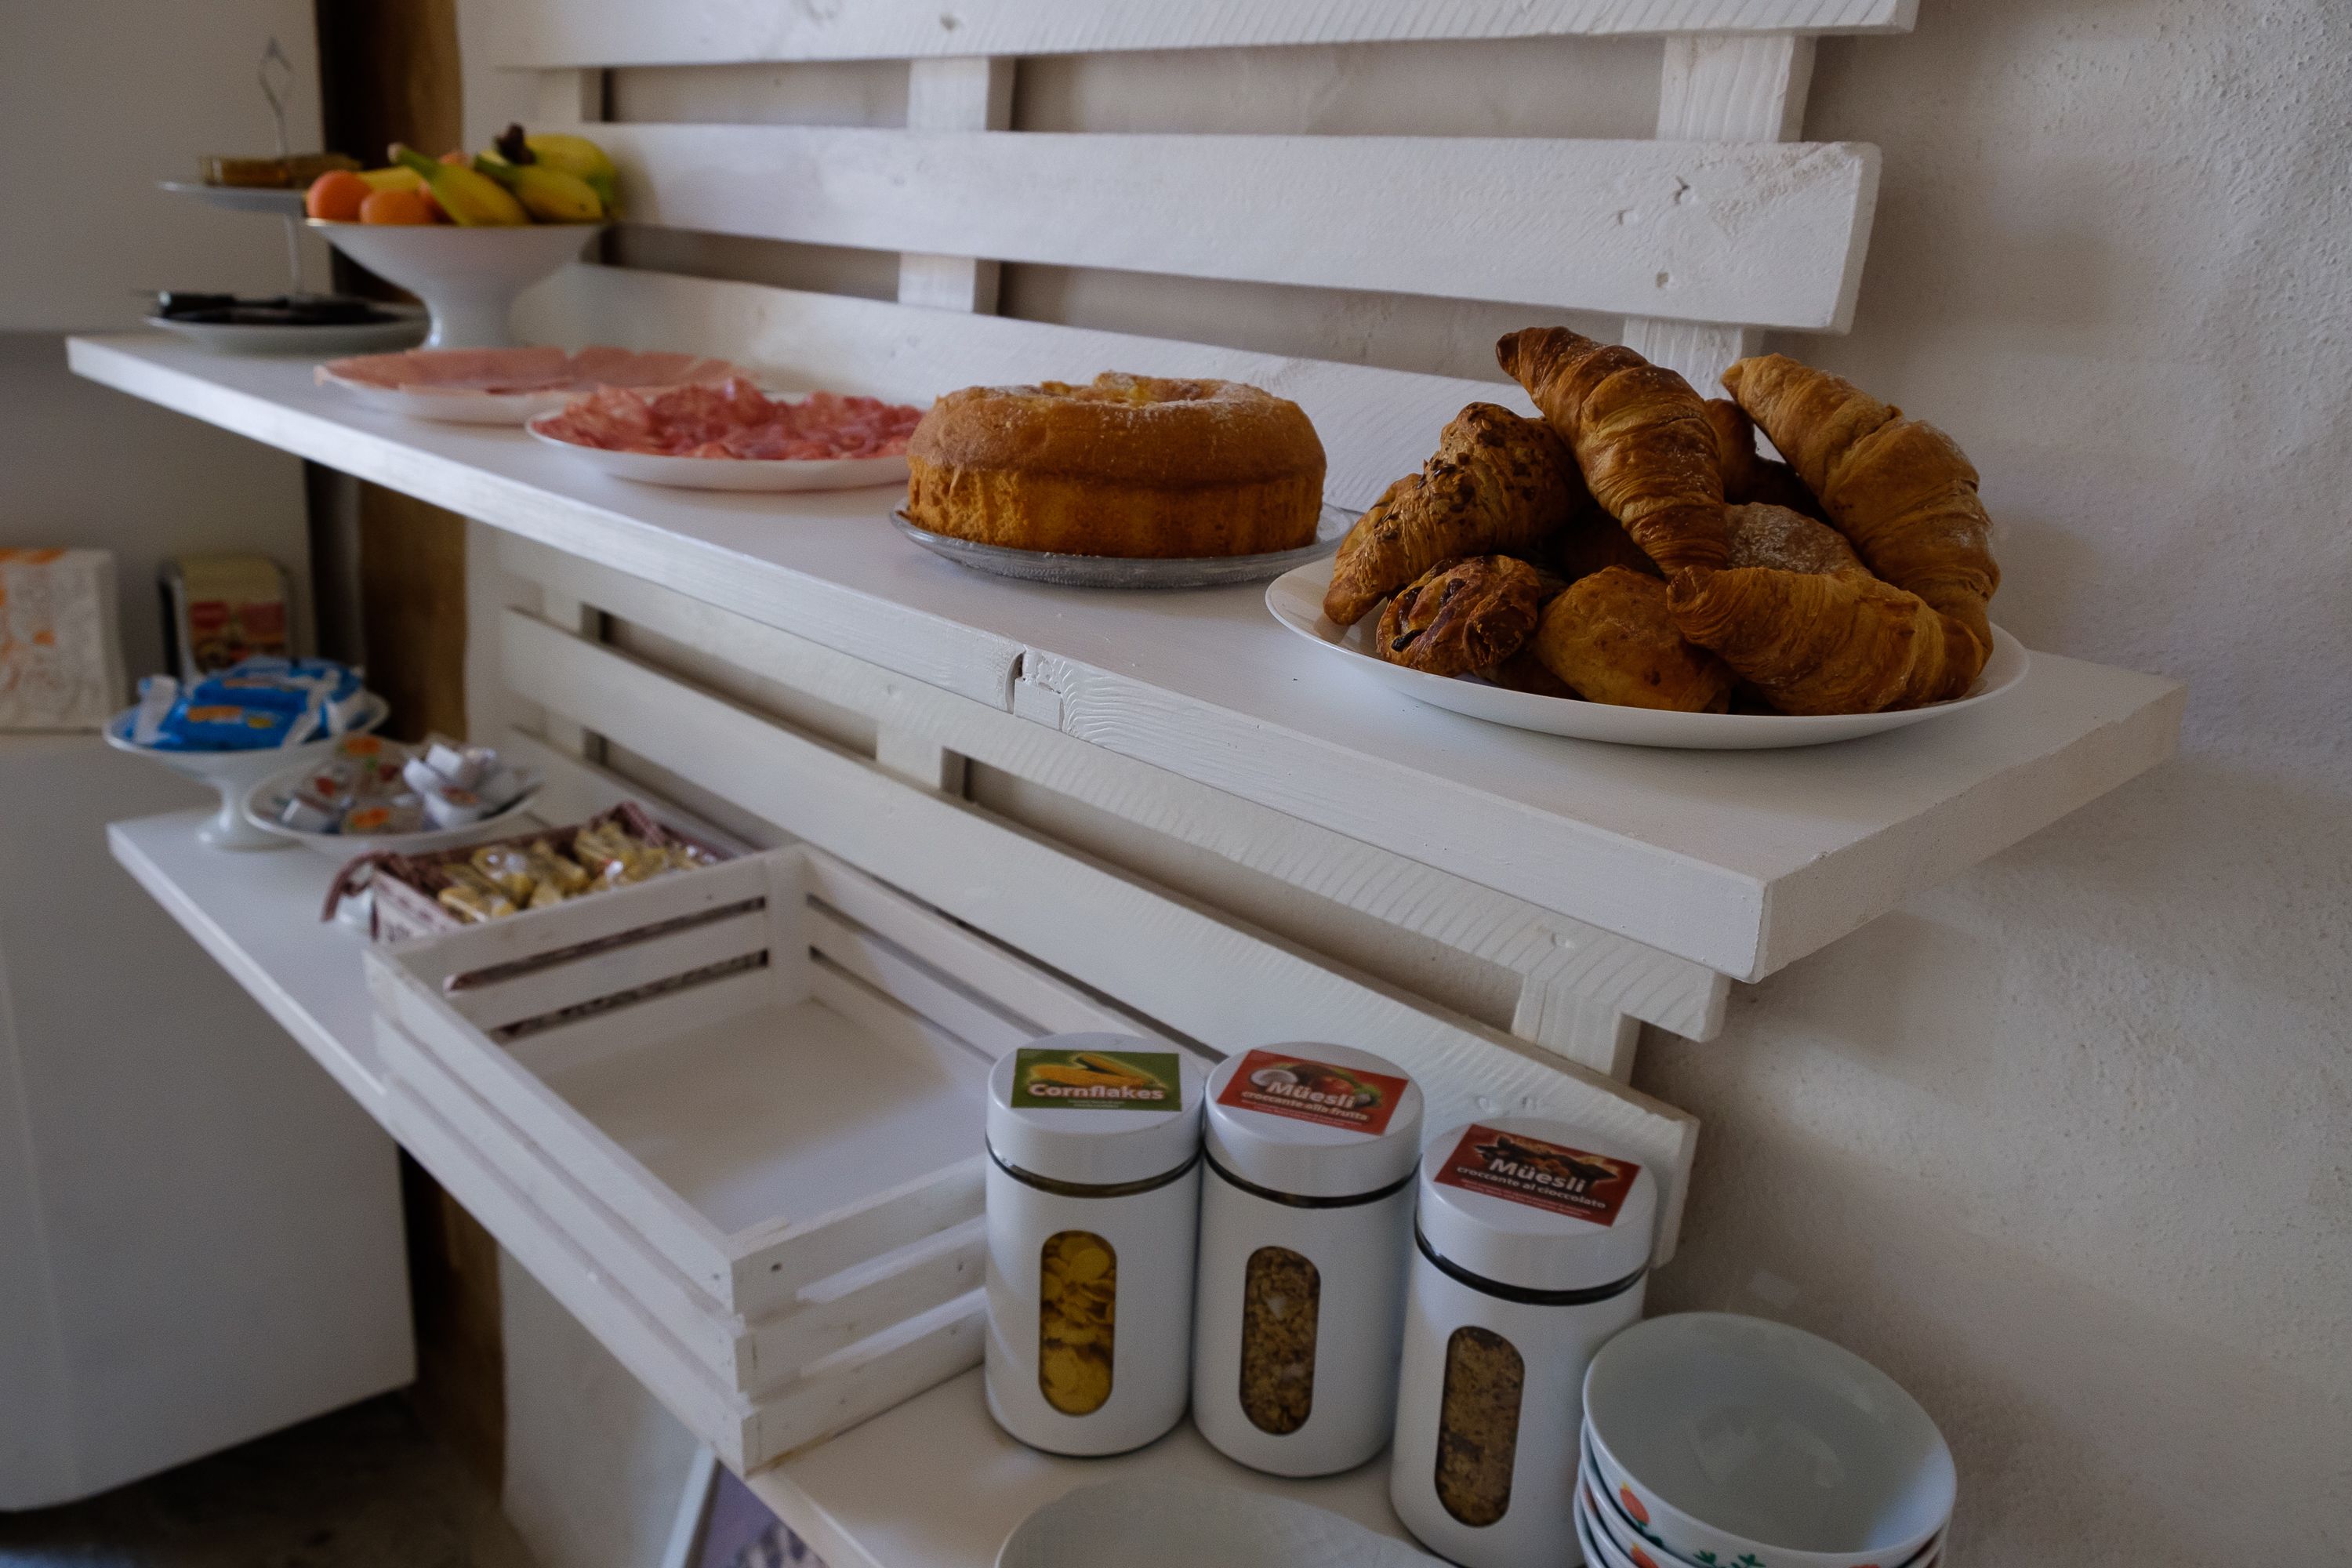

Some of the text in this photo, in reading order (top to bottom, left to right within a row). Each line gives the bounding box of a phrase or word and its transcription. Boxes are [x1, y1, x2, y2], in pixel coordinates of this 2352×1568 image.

[1029, 1083, 1166, 1101] Cornflakes
[1241, 1091, 1303, 1109] croccante
[1305, 1102, 1329, 1113] alla
[1330, 1107, 1370, 1121] frutta
[1265, 1081, 1356, 1109] Müesli
[1457, 1166, 1520, 1187] croccante
[1522, 1181, 1536, 1191] al
[1537, 1185, 1606, 1209] cioccolato
[1489, 1158, 1587, 1193] Müesli
